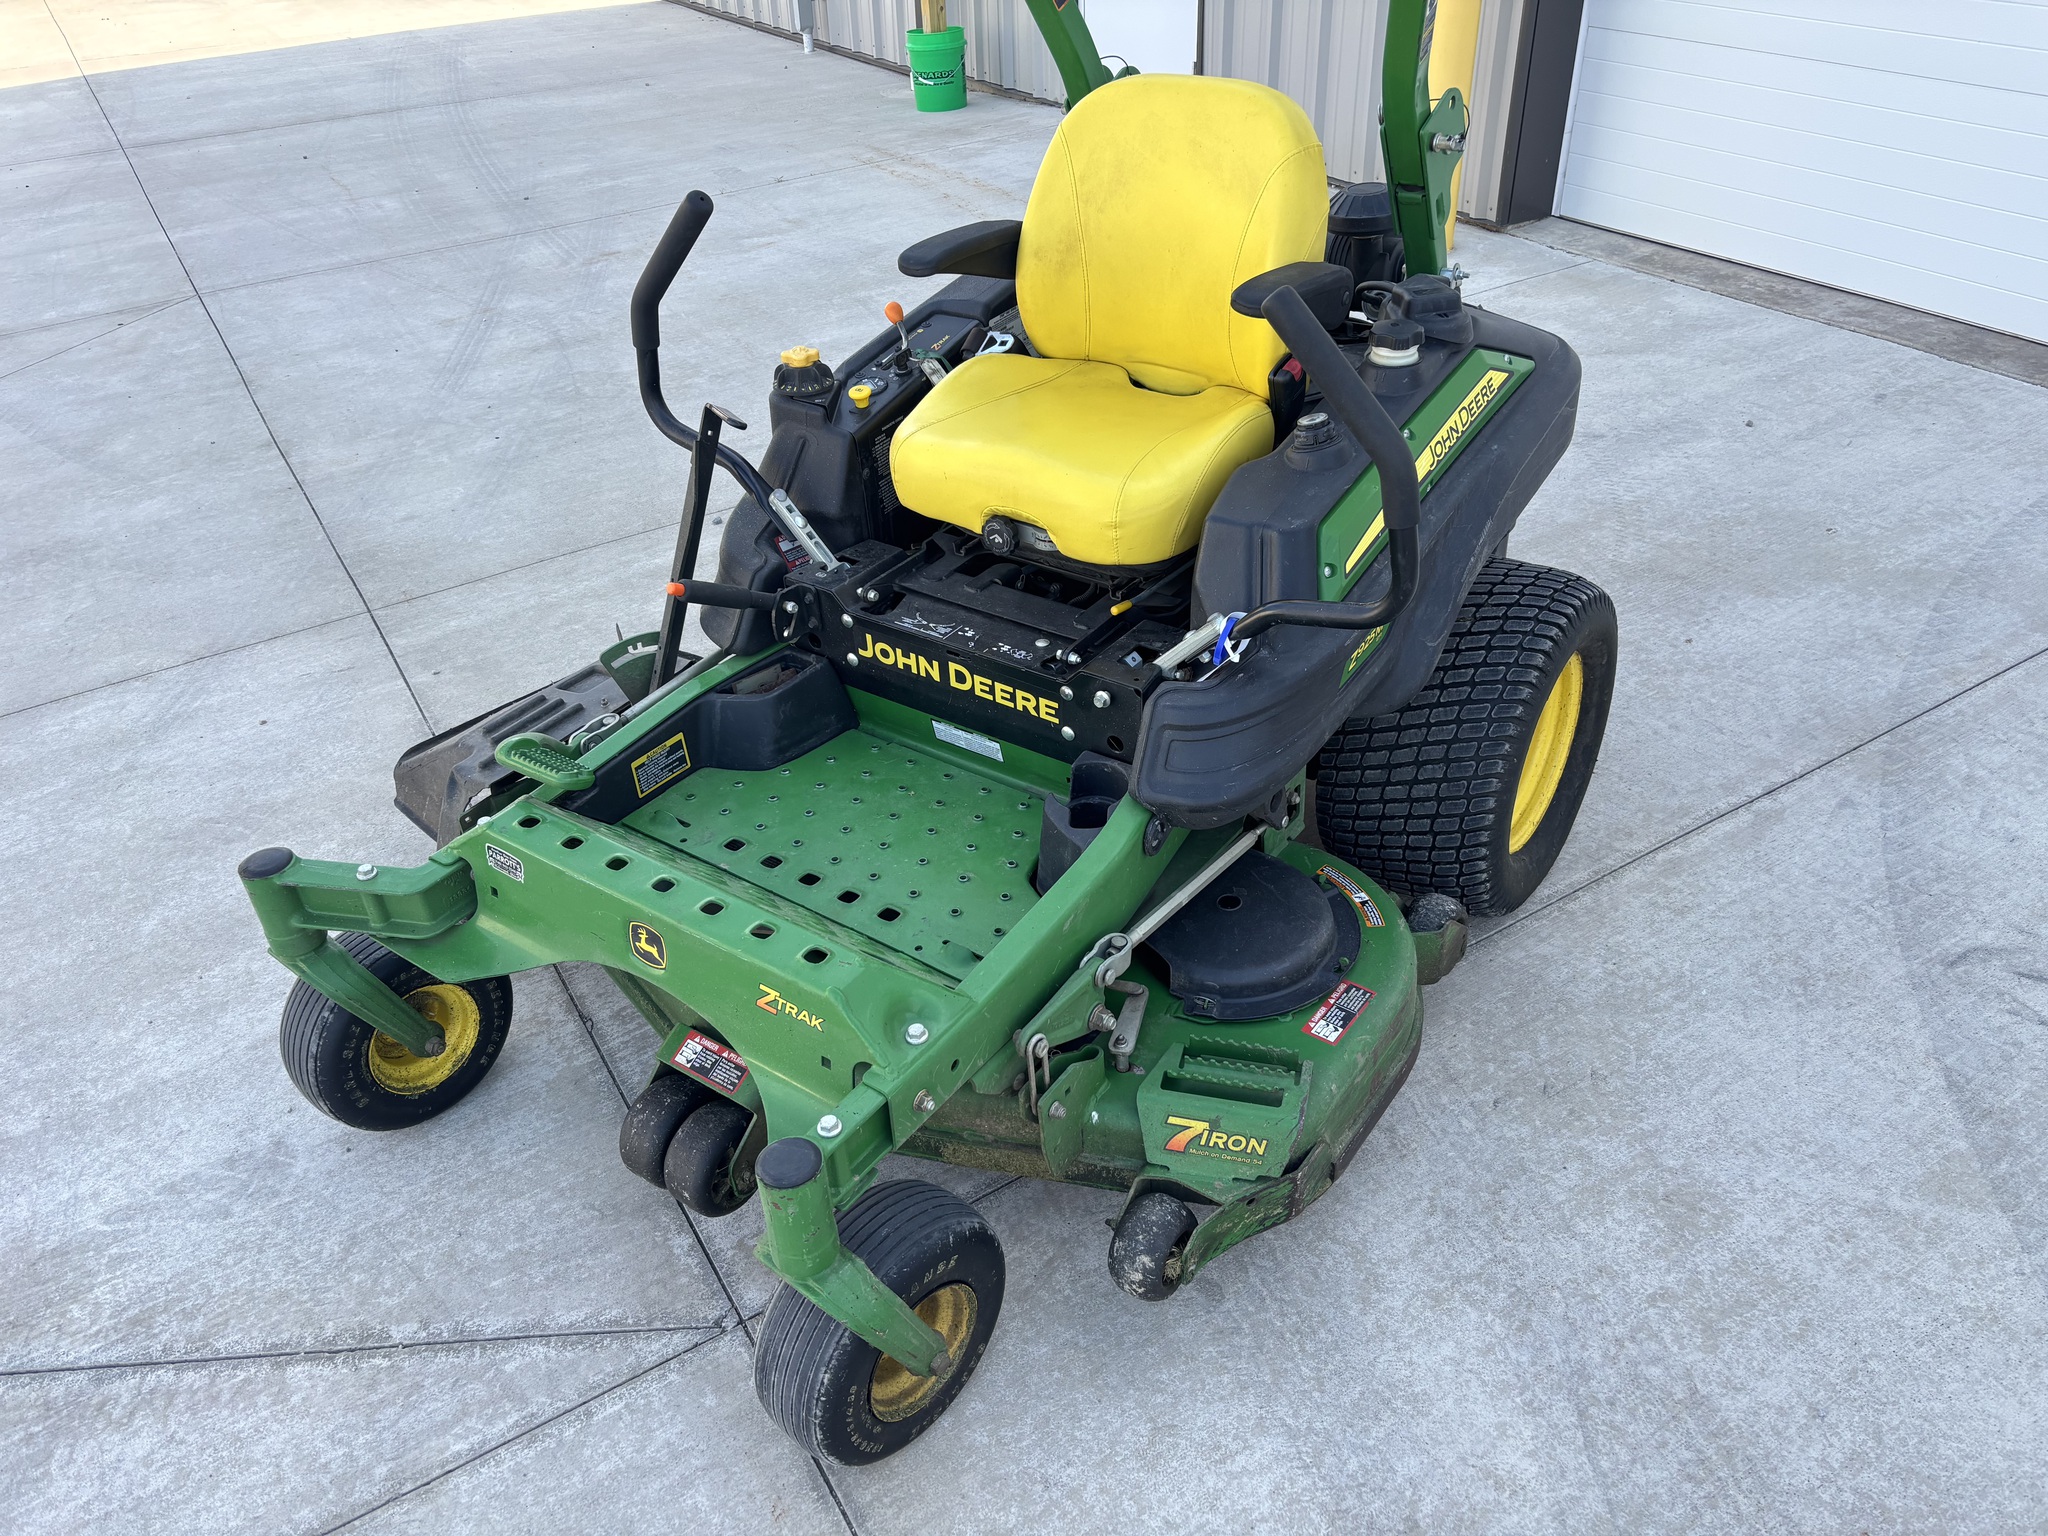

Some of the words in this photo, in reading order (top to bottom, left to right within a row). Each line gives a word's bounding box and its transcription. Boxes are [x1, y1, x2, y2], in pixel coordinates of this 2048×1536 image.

[1428, 420, 1460, 469] JOHN
[1459, 377, 1497, 427] DEERE
[858, 633, 941, 682] JOHN
[948, 661, 1060, 725] DEERE
[1330, 983, 1348, 999] PELIGRO
[755, 983, 826, 1033] ZTRAK
[1311, 1006, 1328, 1023] DANGER
[700, 1037, 720, 1052] DANGER
[1188, 1148, 1209, 1156] Mulch
[1221, 1153, 1251, 1163] Demand
